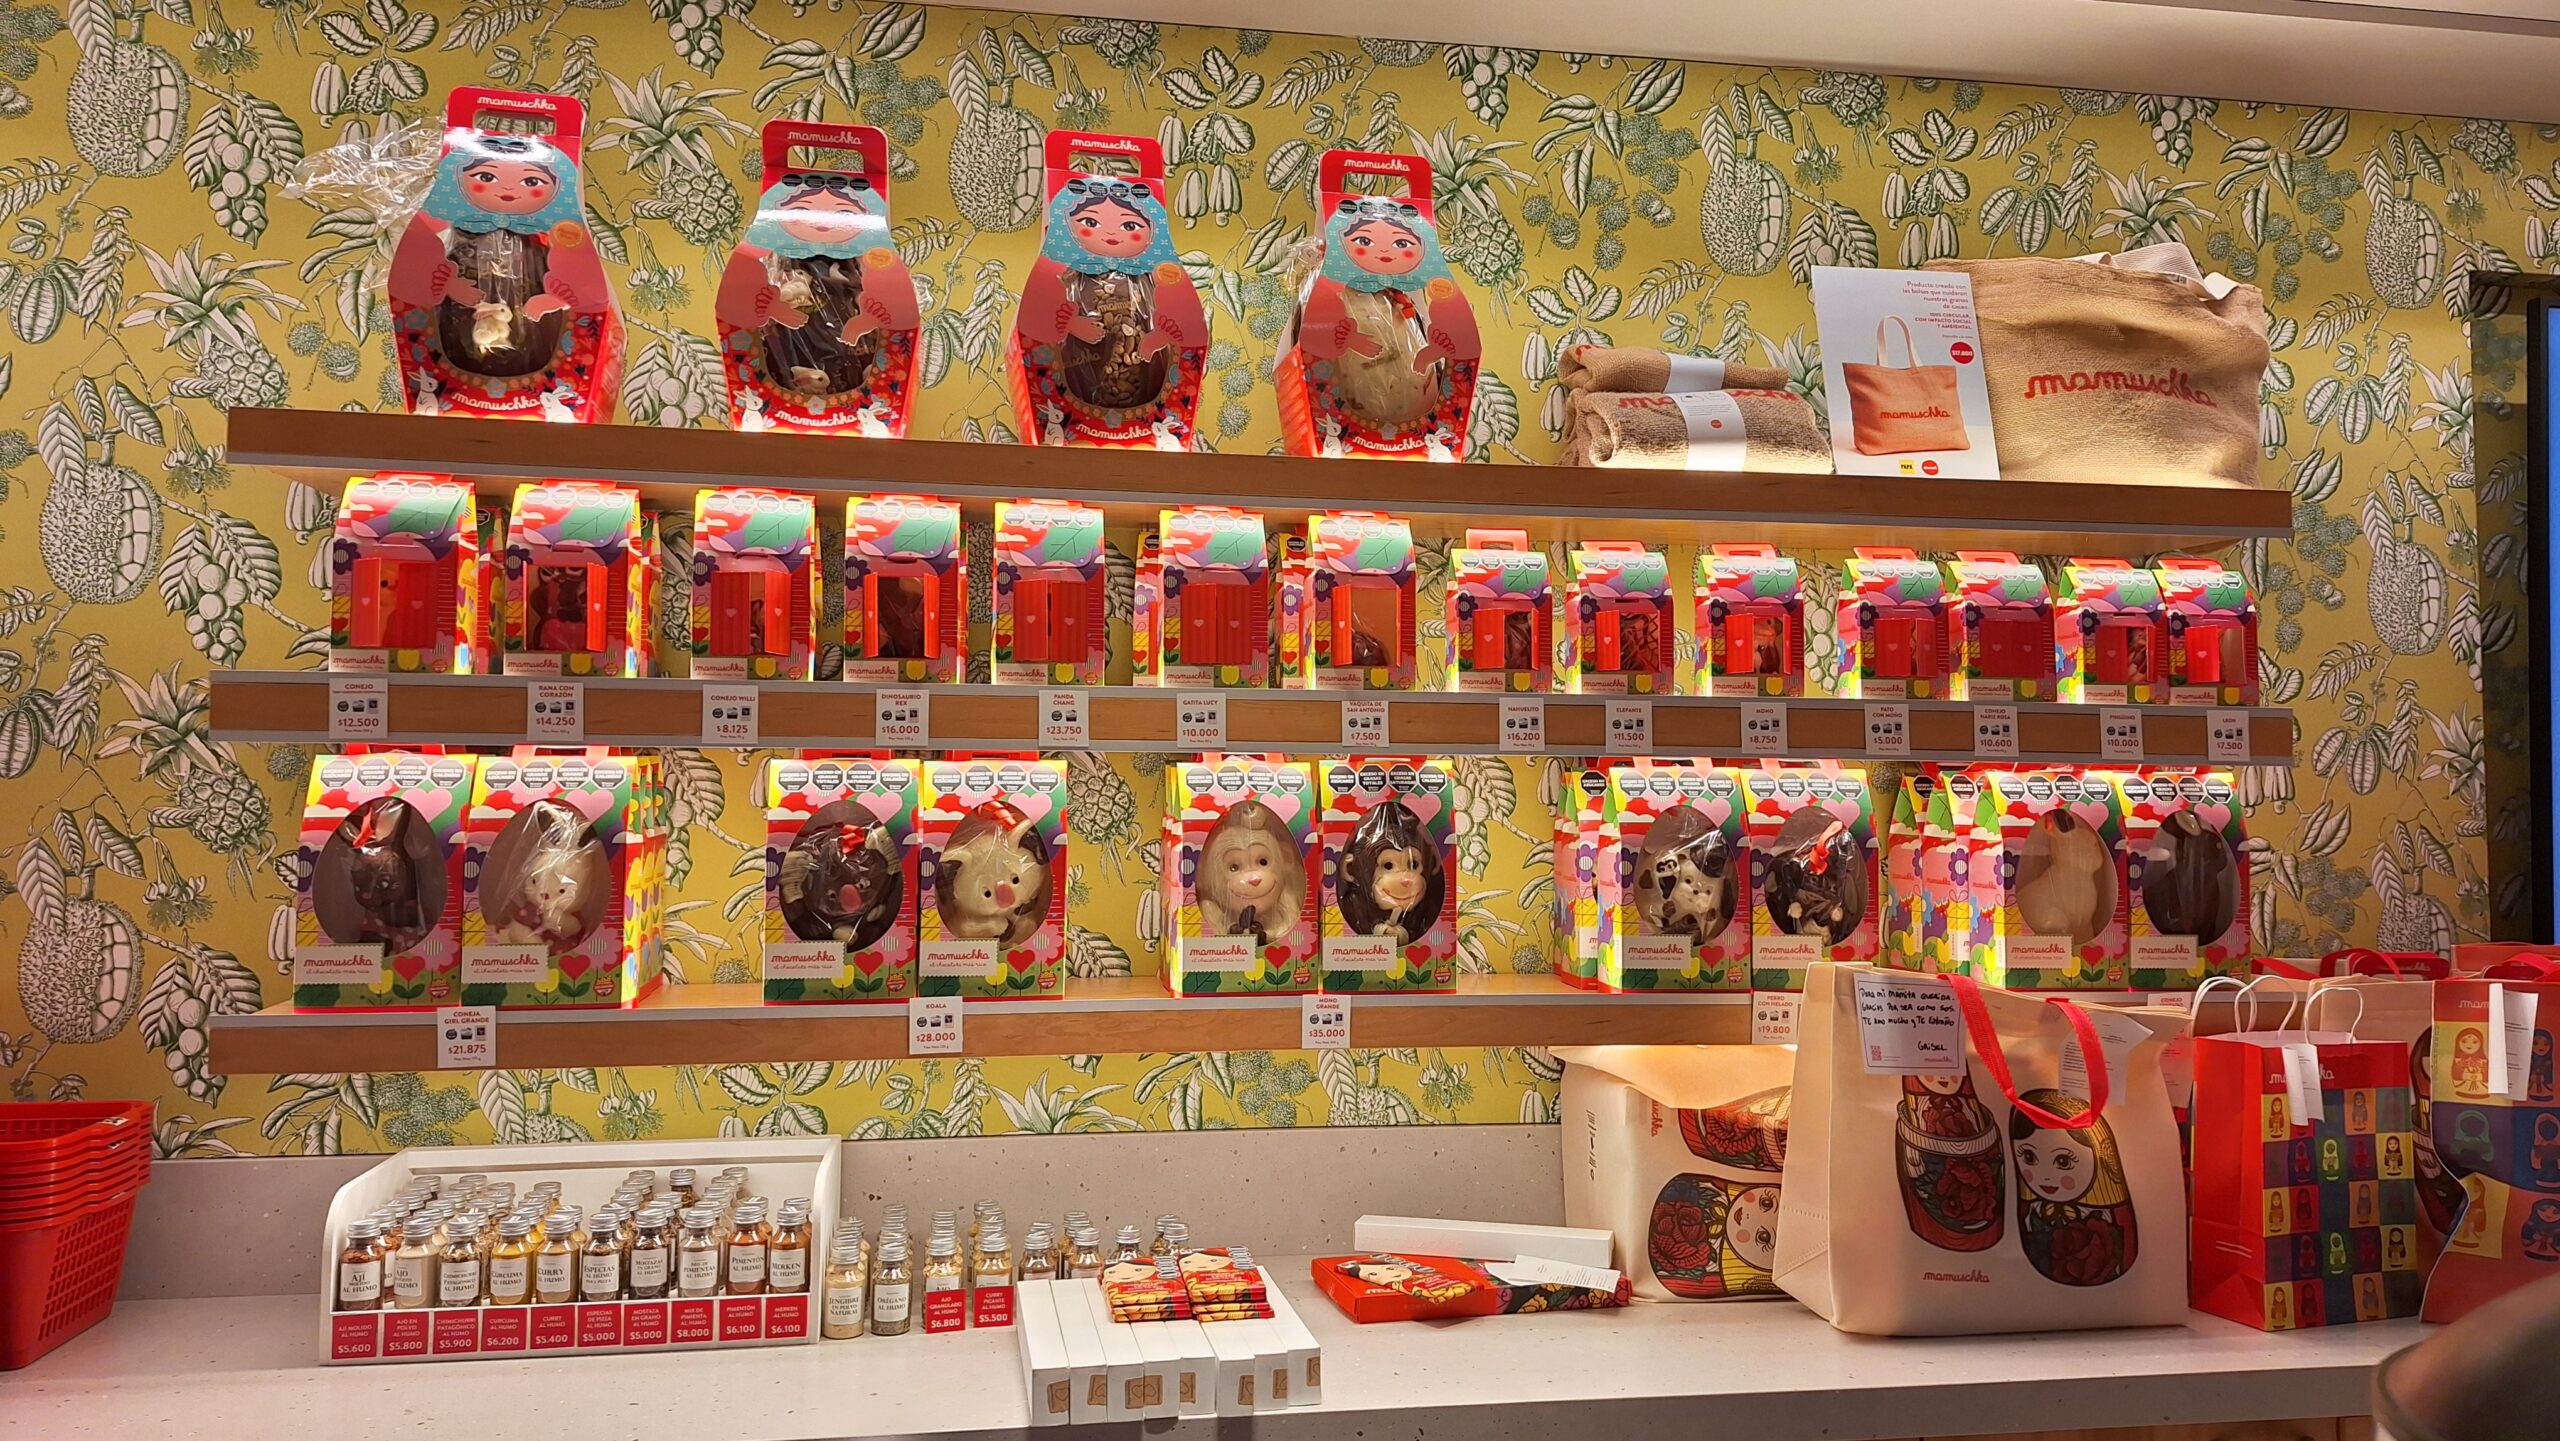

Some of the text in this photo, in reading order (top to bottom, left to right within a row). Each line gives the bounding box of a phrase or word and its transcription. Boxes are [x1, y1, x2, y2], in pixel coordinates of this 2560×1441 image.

[477, 95, 556, 111] mamuschka
[788, 130, 862, 146] mamuschka
[1071, 138, 1141, 153] mamuschka
[1344, 158, 1410, 172] mamuschka
[2025, 366, 2217, 408] mamuschka
[453, 391, 541, 412] mamuschka
[1880, 406, 1951, 419] mamuschka
[774, 412, 857, 428] mamuschka
[1076, 423, 1151, 439] mamuschka
[1353, 435, 1425, 451] mamuschka
[338, 718, 379, 727] $12.500
[536, 717, 575, 726] $14.250
[882, 725, 920, 734] $16.000
[1046, 726, 1082, 735] $23.750
[1182, 729, 1218, 737] $10.000
[1351, 732, 1381, 741] $7.500
[1507, 732, 1540, 741] $16.200
[1614, 733, 1644, 741] $11.500
[1750, 736, 1777, 744] $8.750
[1874, 737, 1903, 745] $5.000
[1981, 739, 2012, 747] $10.600
[2217, 742, 2243, 750] $7.500
[1190, 946, 1248, 956] mamuschka
[1332, 946, 1390, 956] mamuschka
[1628, 944, 1685, 955] mamuschka
[1759, 944, 1816, 955] mamuschka
[2012, 944, 2066, 955] mamuschka
[2138, 945, 2191, 955] mamuschka
[772, 952, 836, 962] mamuschka
[927, 950, 990, 960] mamuschka
[304, 958, 374, 967] mamuschka
[471, 958, 540, 967] mamuschka
[1309, 1029, 1345, 1037] $35.000
[1758, 1026, 1790, 1034] $19.800
[916, 1032, 956, 1042] $28.000
[448, 1044, 486, 1054] $21.875
[1923, 1270, 1990, 1284] mamuschka
[352, 1284, 377, 1292] HUMO
[979, 1314, 1008, 1323] $5.500
[931, 1319, 960, 1328] $6.800
[676, 1328, 710, 1338] $8.000
[726, 1325, 755, 1334] $6.100
[771, 1325, 800, 1334] $6.100
[535, 1335, 568, 1344] $5.400
[583, 1332, 615, 1342] $5.000
[630, 1330, 662, 1340] $5.000
[389, 1341, 422, 1351] $5.800
[439, 1339, 472, 1348] $5.900
[487, 1337, 519, 1346] $6.200
[338, 1344, 371, 1353] $5.600
